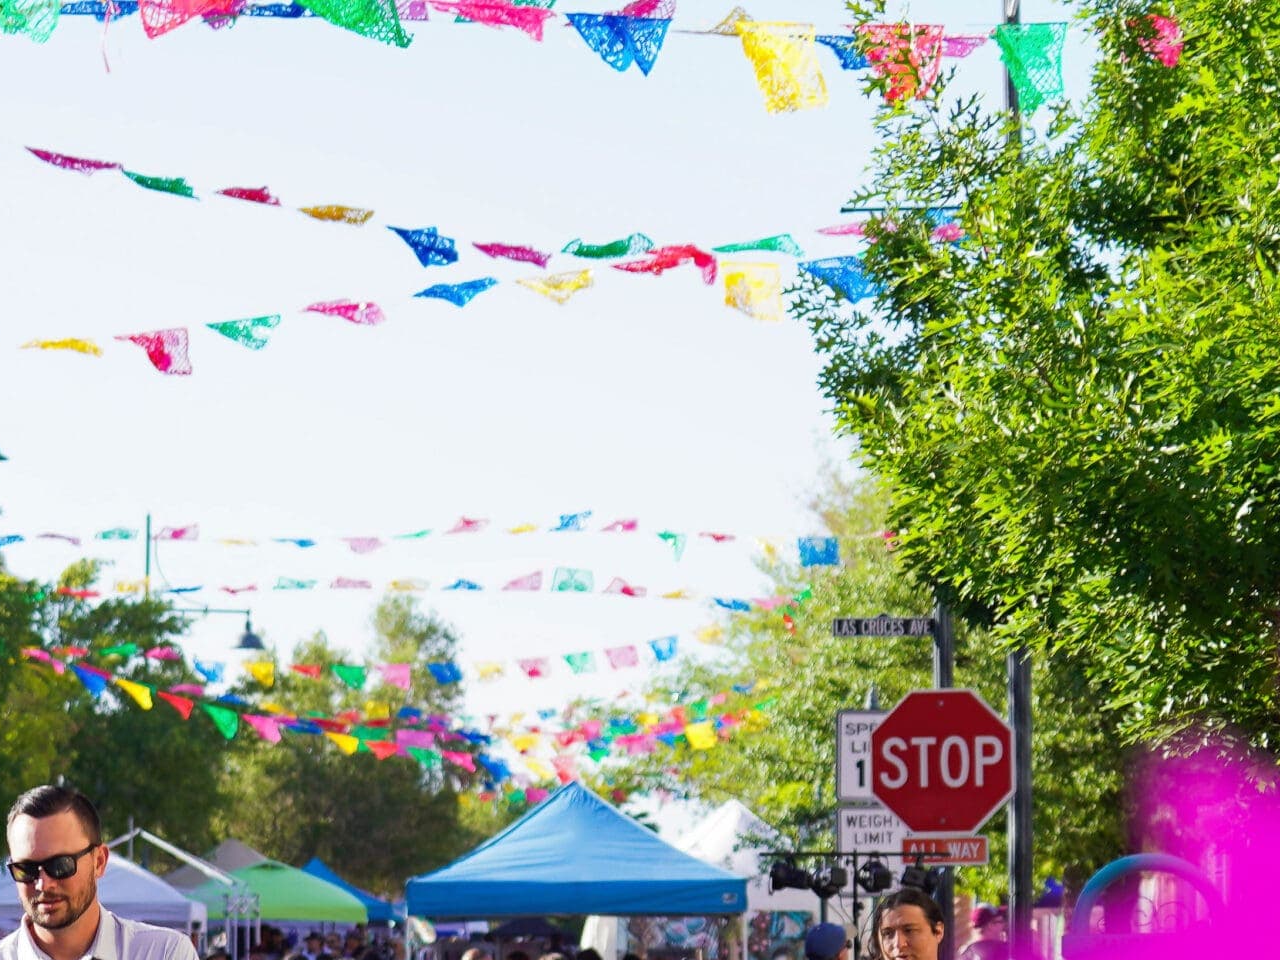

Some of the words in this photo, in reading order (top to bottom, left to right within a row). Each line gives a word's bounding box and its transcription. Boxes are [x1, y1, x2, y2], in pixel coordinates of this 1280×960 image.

[834, 619, 857, 636] LAS
[861, 619, 905, 636] CRUCES
[910, 619, 931, 635] AVE
[879, 735, 1004, 789] STOP
[854, 831, 894, 845] LIMIT
[910, 842, 938, 860] ALL
[948, 842, 981, 859] WAY
